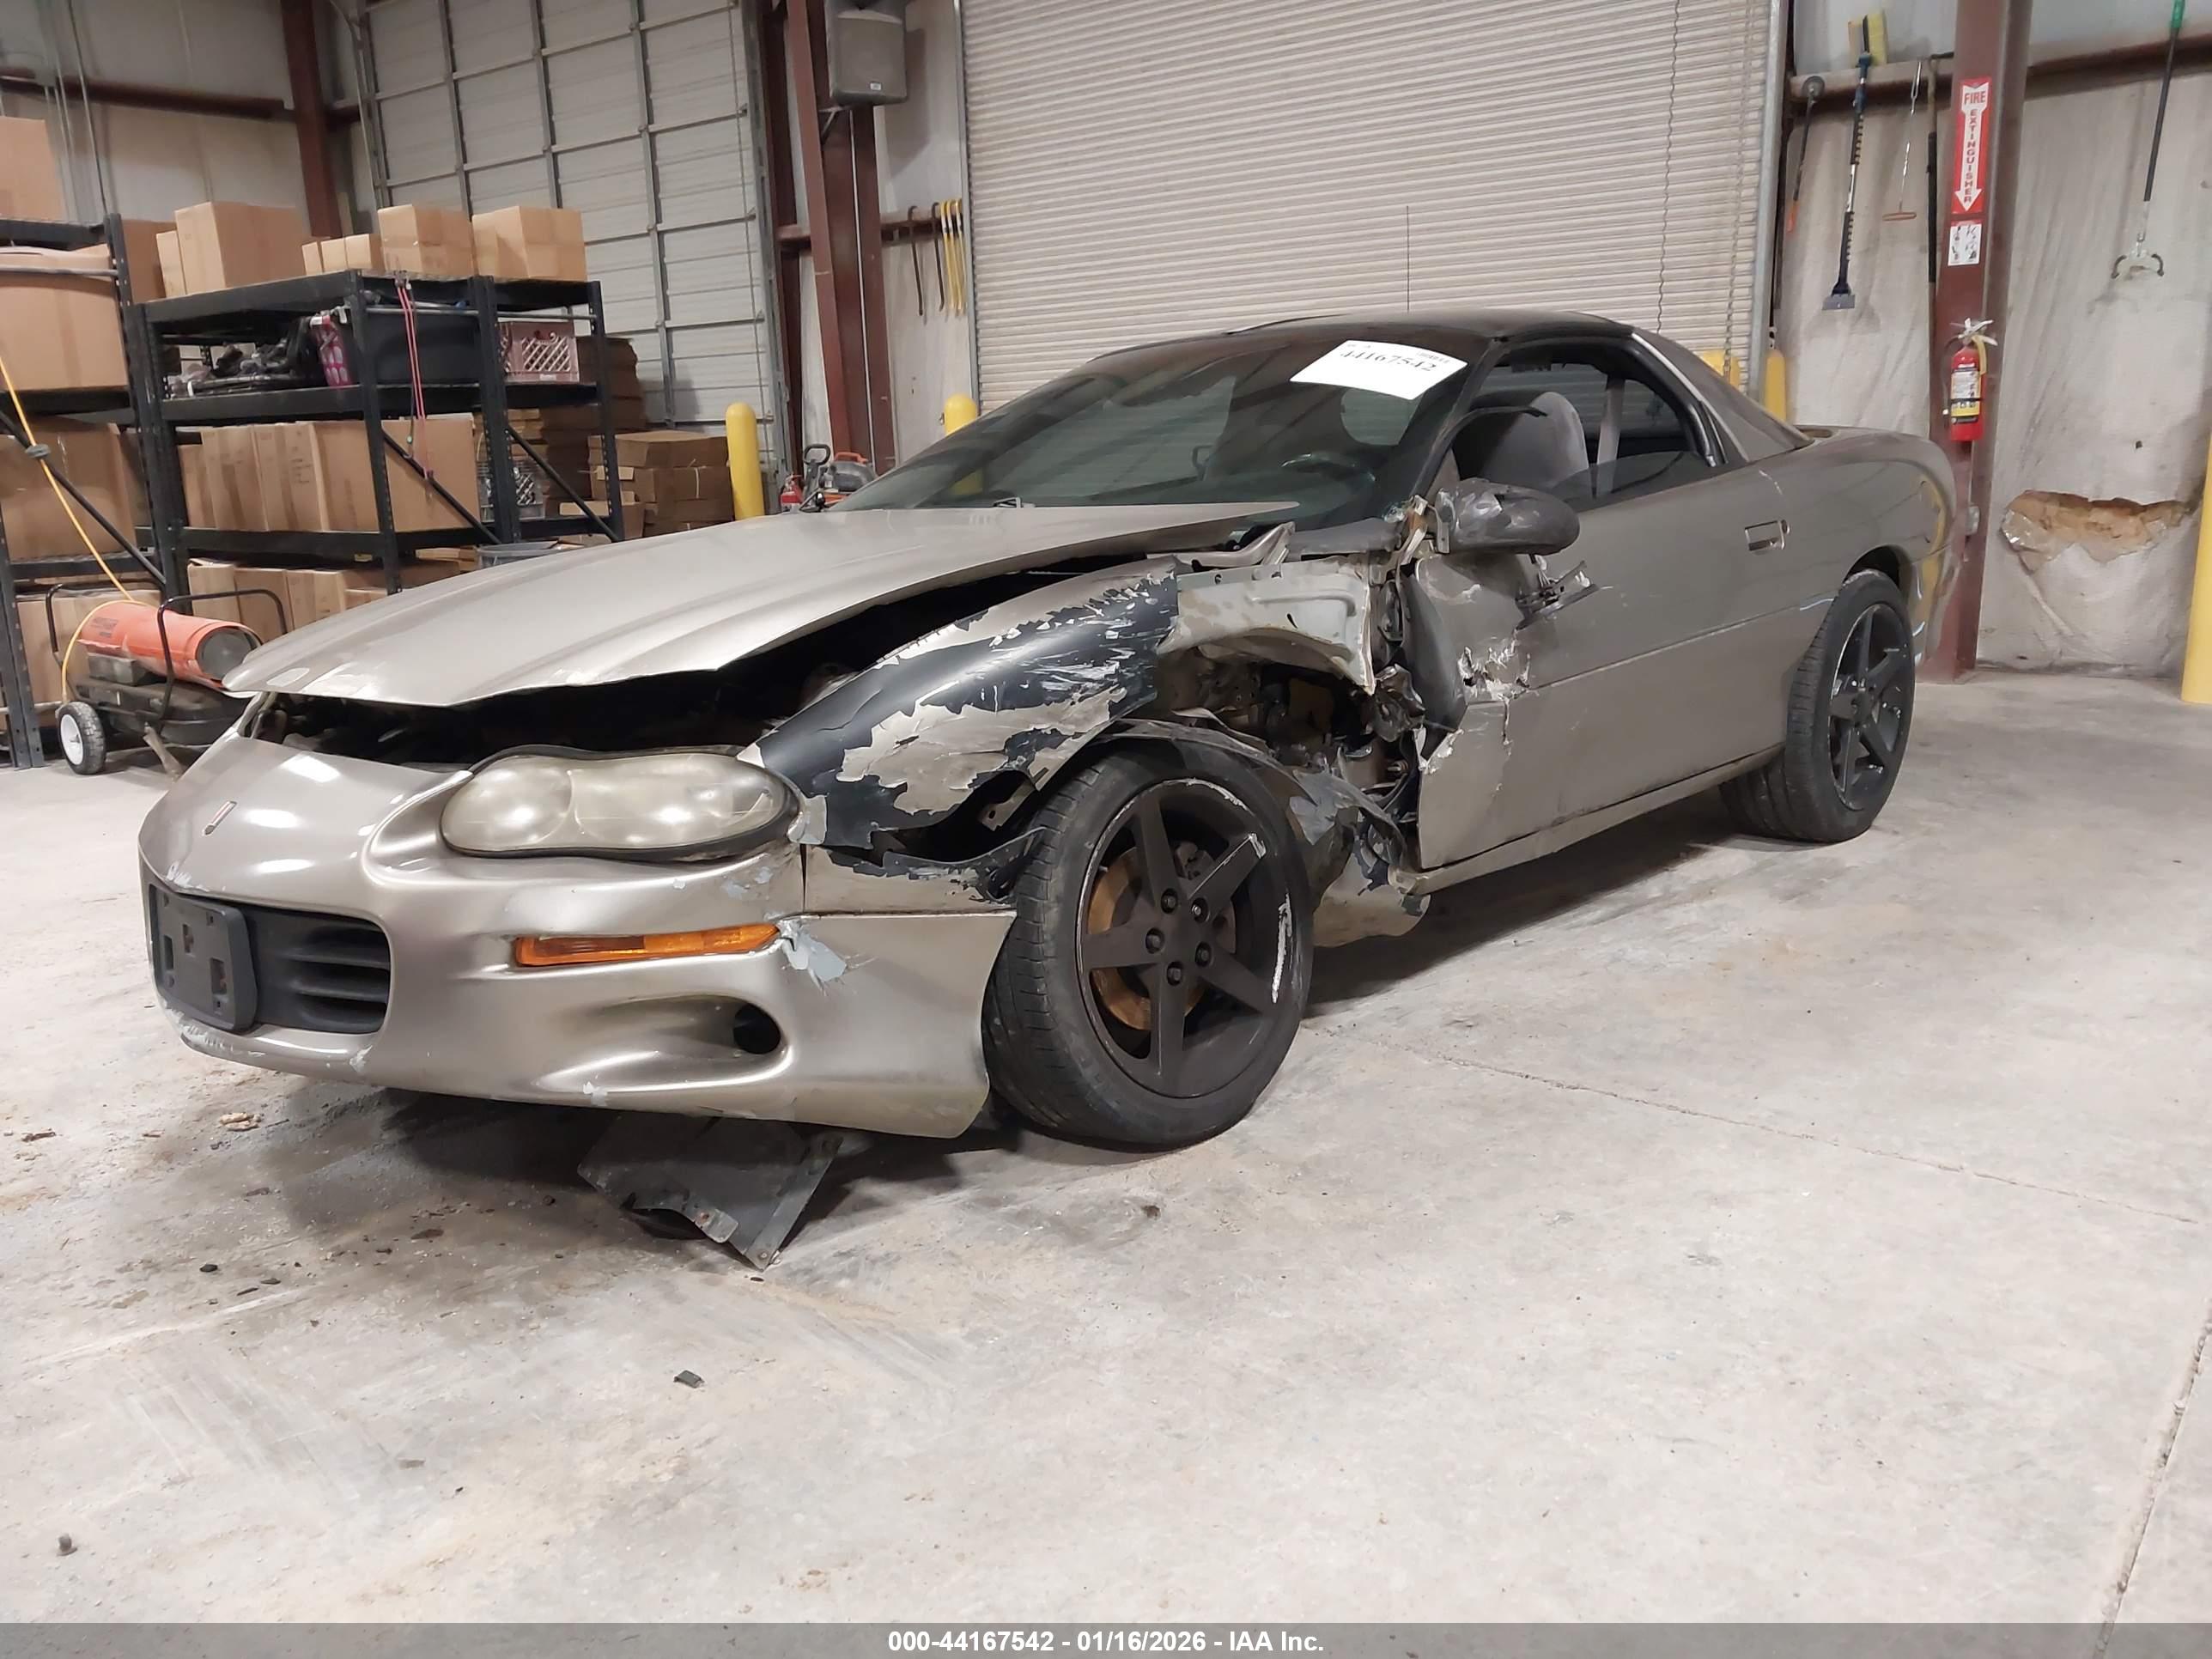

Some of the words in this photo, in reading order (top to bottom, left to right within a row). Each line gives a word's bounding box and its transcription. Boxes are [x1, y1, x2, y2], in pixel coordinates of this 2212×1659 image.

[1964, 90, 1986, 105] FIRE
[1964, 108, 1978, 203] EXTINGUISHER
[1340, 349, 1437, 372] 44167542
